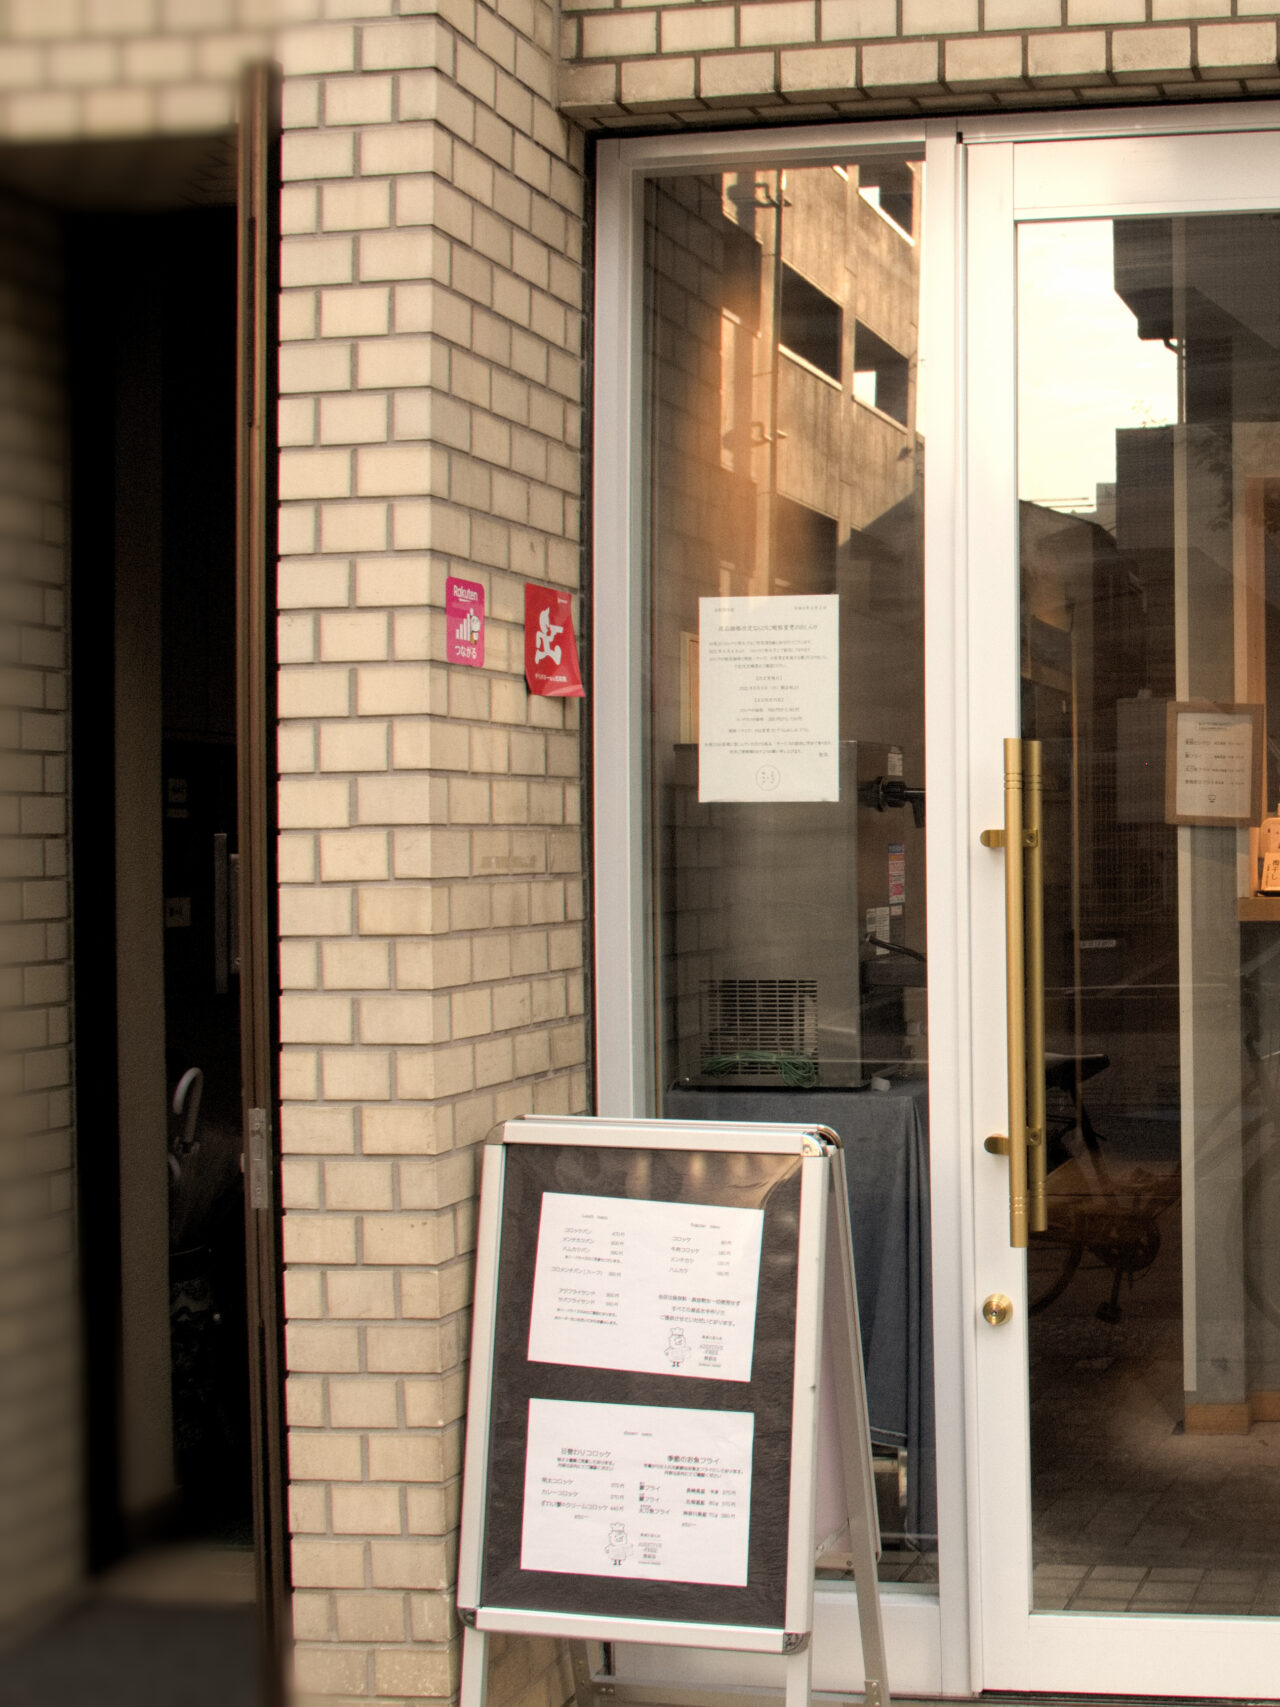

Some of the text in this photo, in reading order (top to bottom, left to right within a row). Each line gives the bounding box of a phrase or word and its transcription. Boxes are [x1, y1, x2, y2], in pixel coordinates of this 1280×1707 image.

[453, 584, 478, 600] Rakuten
[455, 645, 477, 660] つながる
